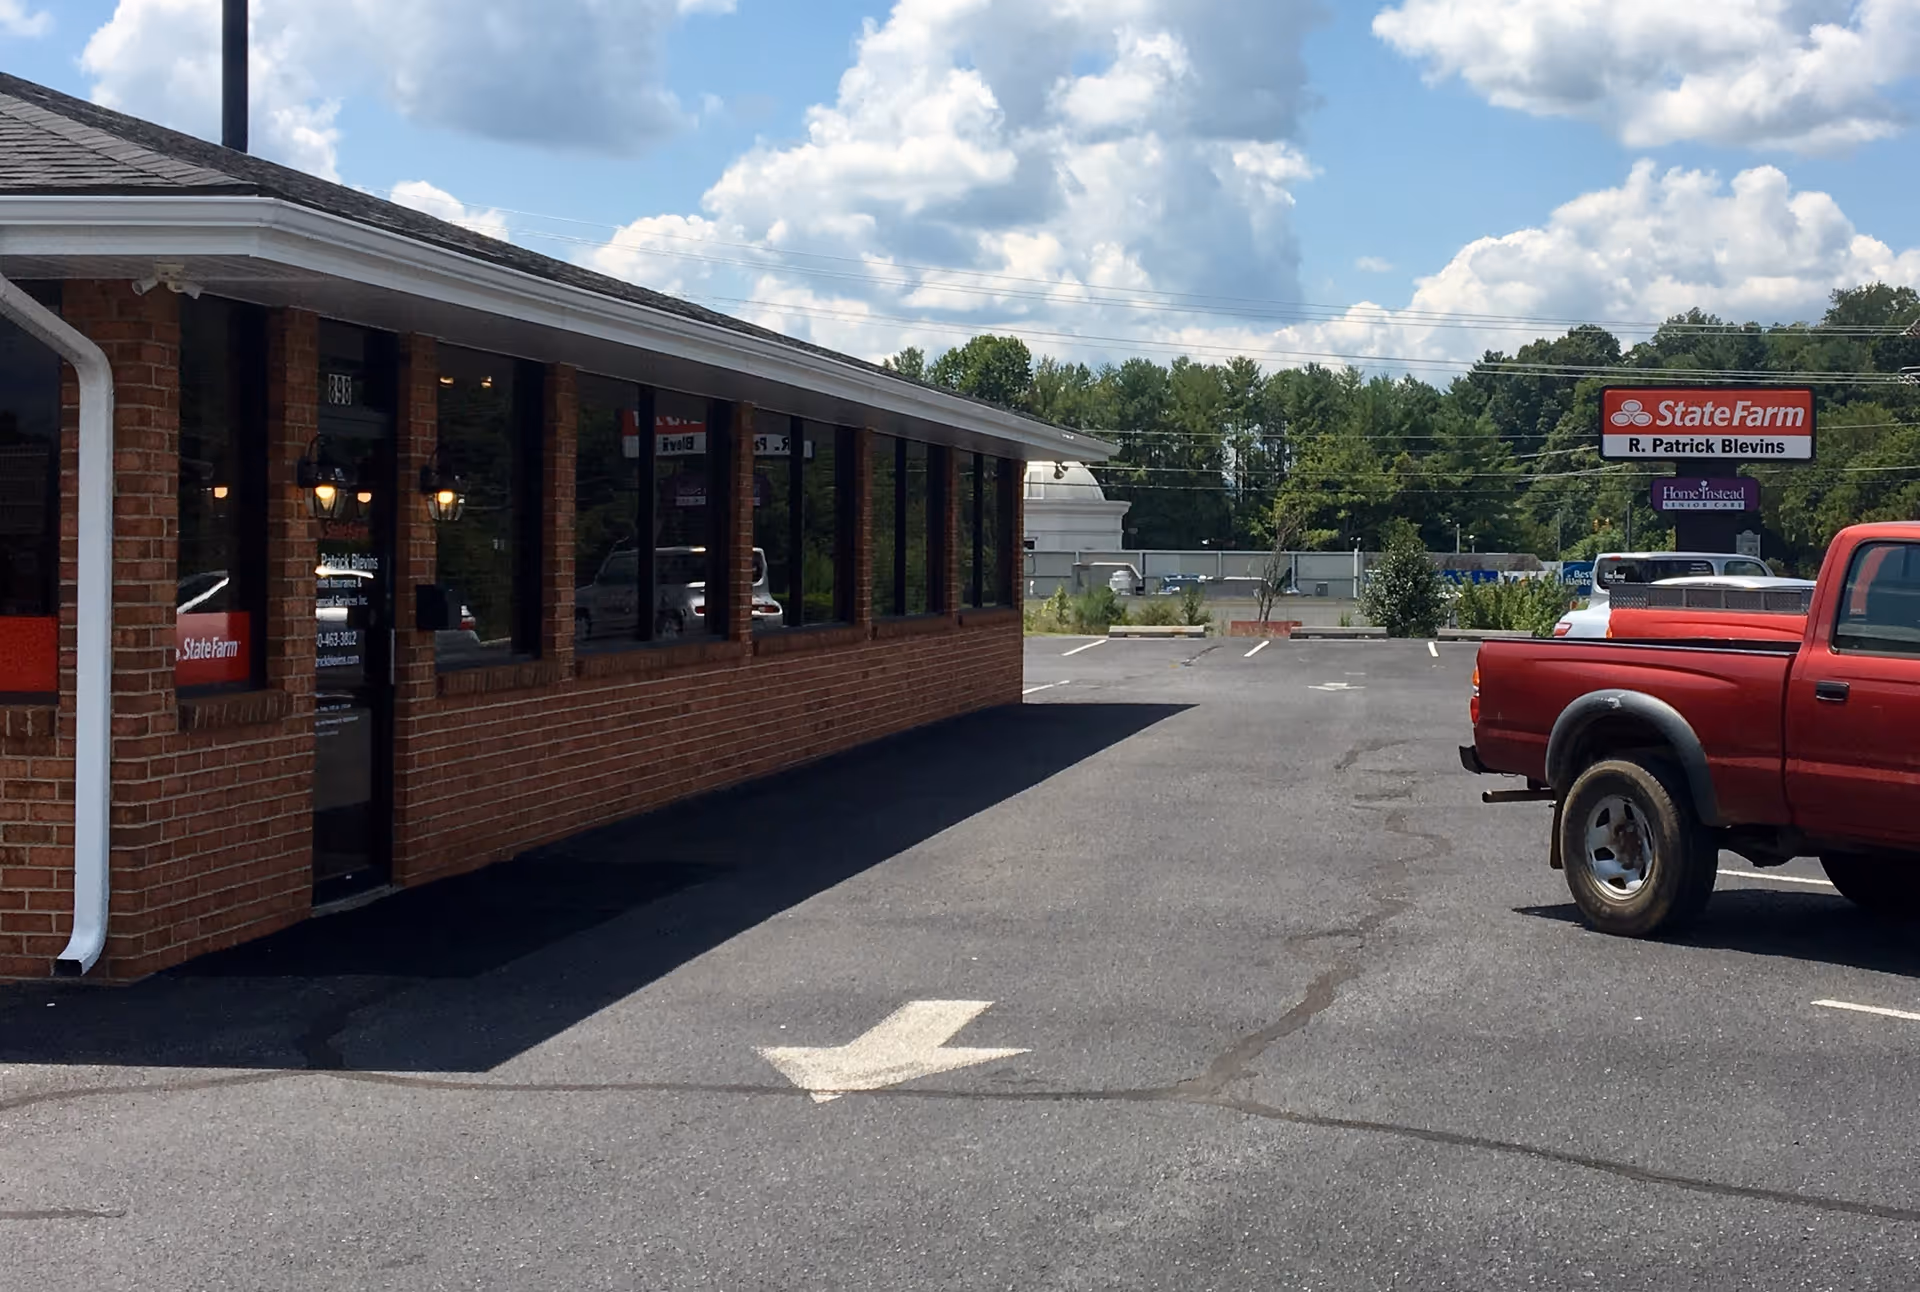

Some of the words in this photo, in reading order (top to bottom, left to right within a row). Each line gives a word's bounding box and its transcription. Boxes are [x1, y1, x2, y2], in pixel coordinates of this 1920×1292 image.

[1628, 438, 1646, 453] R.
[1652, 438, 1715, 454] Patrick
[1721, 438, 1785, 454] Blevins
[321, 553, 350, 569] Patrick
[351, 553, 378, 570] Blevins
[1565, 577, 1592, 586] Weste
